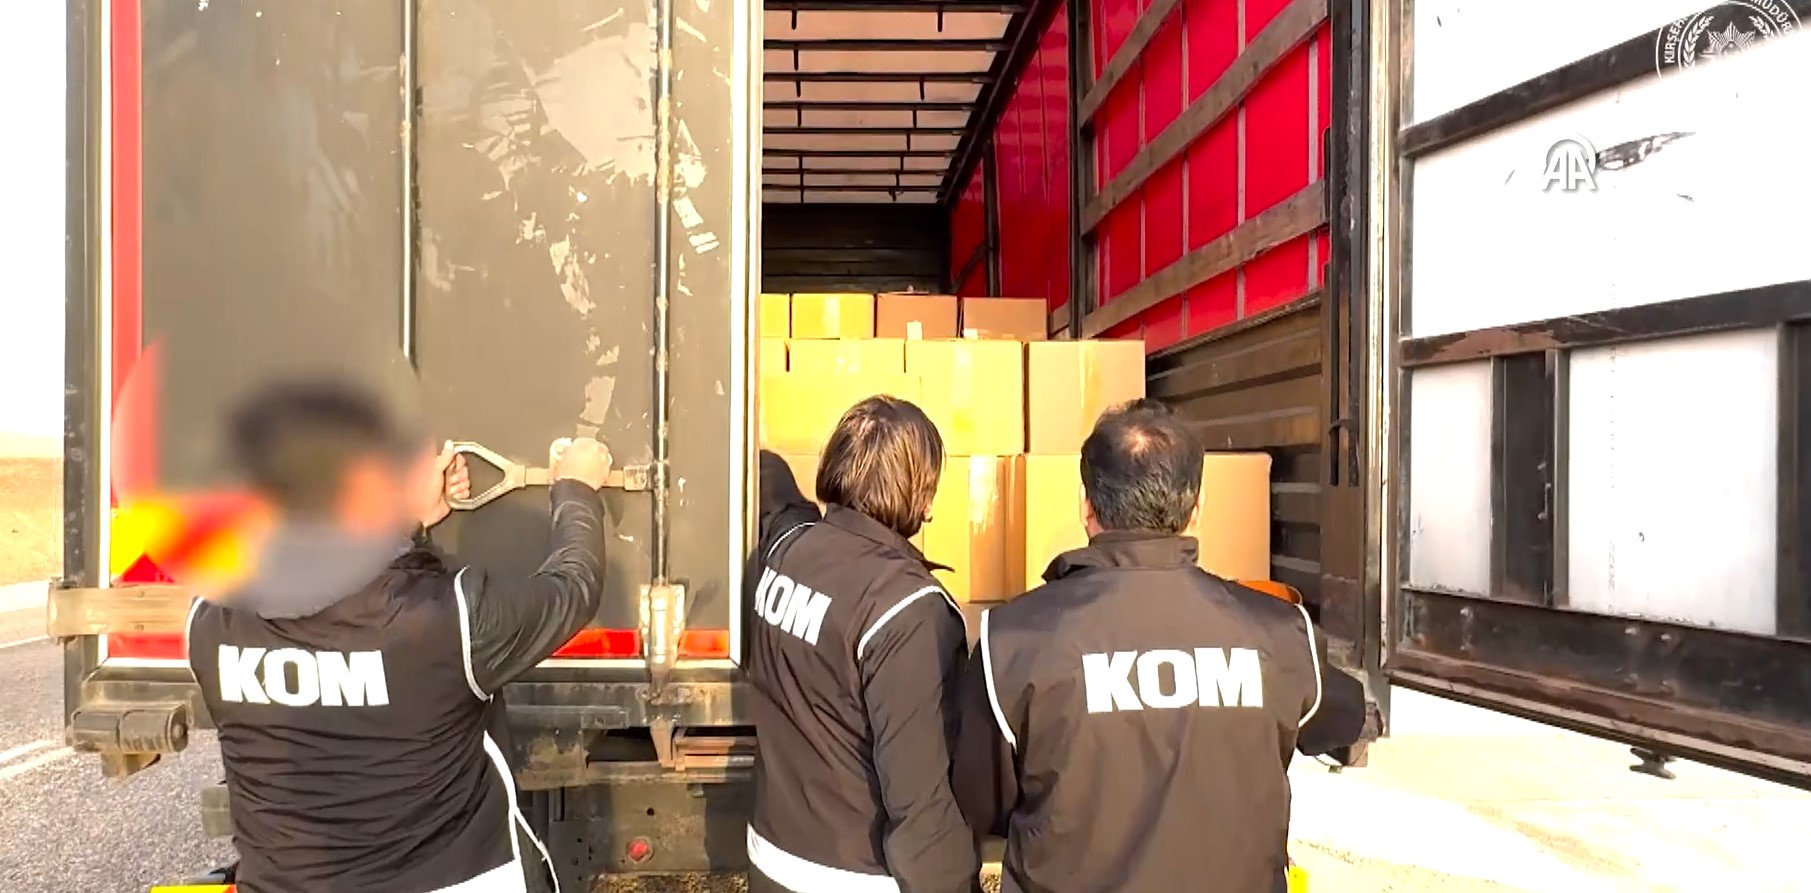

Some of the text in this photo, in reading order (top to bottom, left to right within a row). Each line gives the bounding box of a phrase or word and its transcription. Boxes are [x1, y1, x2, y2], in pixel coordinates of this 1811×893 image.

[753, 565, 832, 647] KOM
[217, 643, 390, 708] KOM
[1082, 646, 1264, 713] KOM
